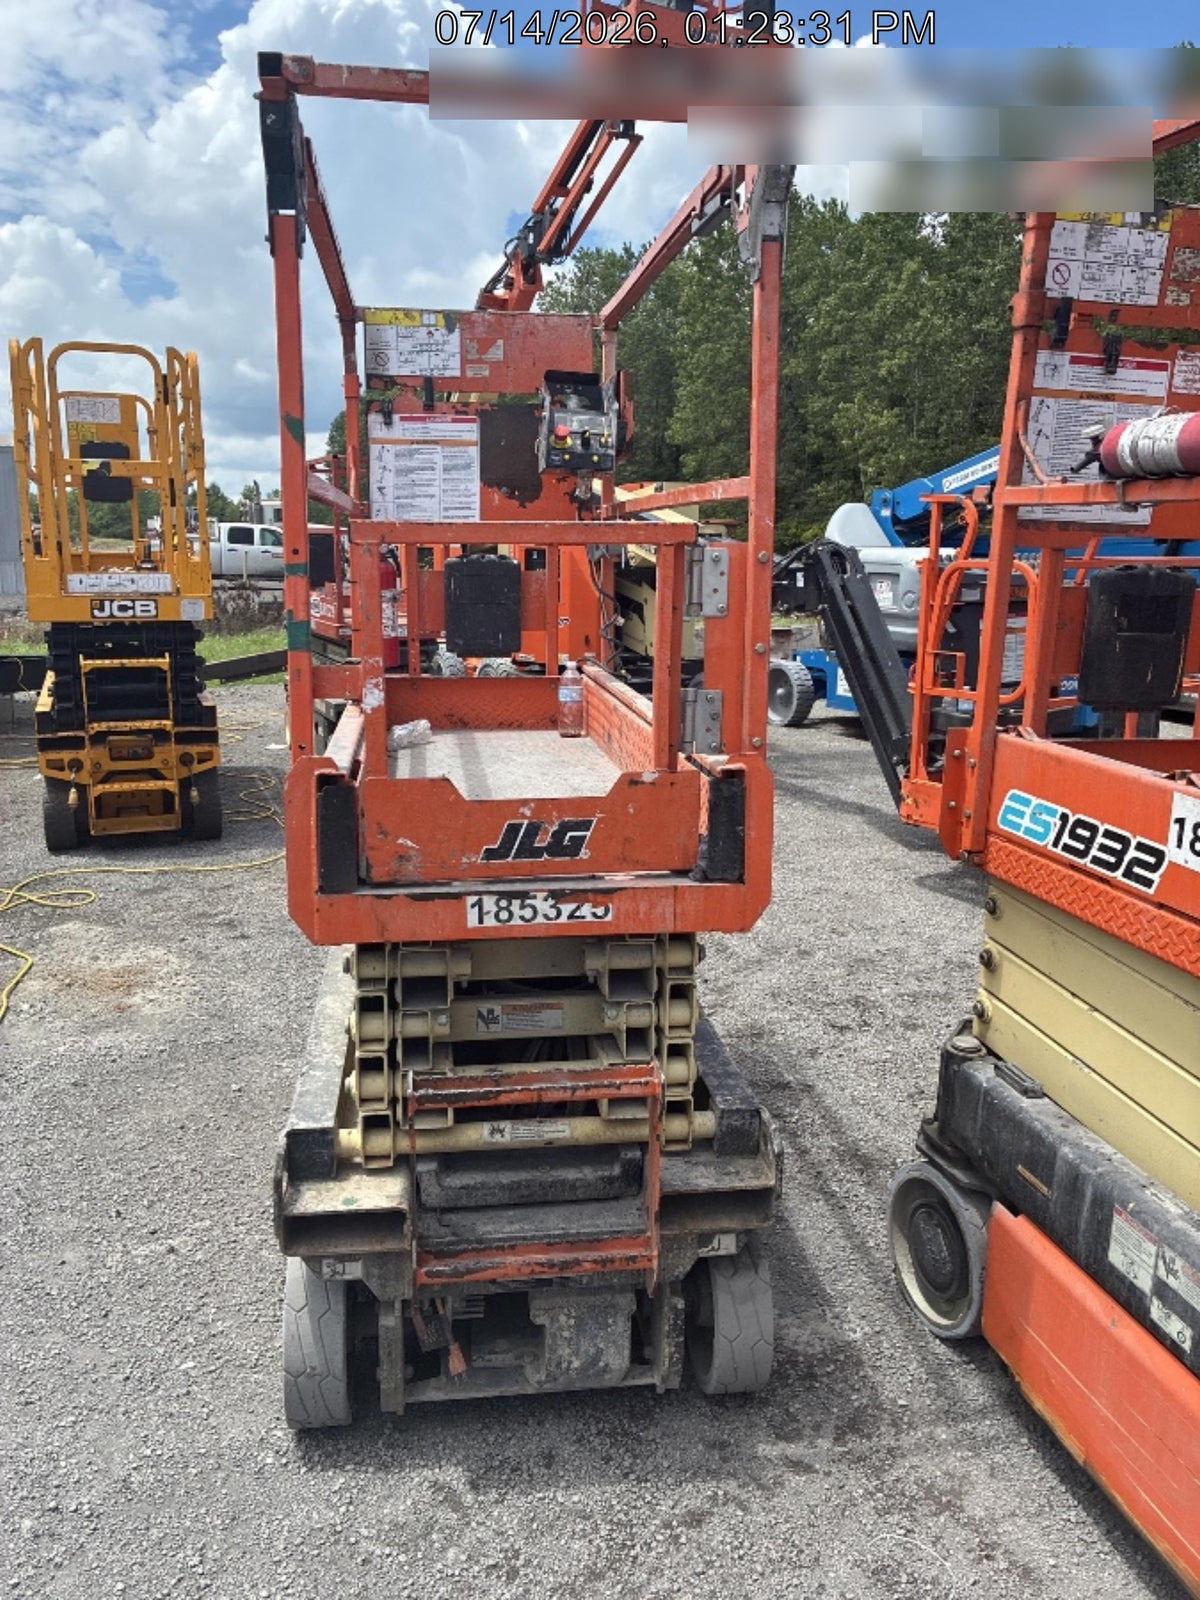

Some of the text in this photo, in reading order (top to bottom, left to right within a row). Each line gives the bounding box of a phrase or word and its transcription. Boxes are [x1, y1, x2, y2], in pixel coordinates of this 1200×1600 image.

[92, 600, 157, 618] JCB
[478, 818, 597, 862] JLG
[1000, 792, 1167, 890] ES1932
